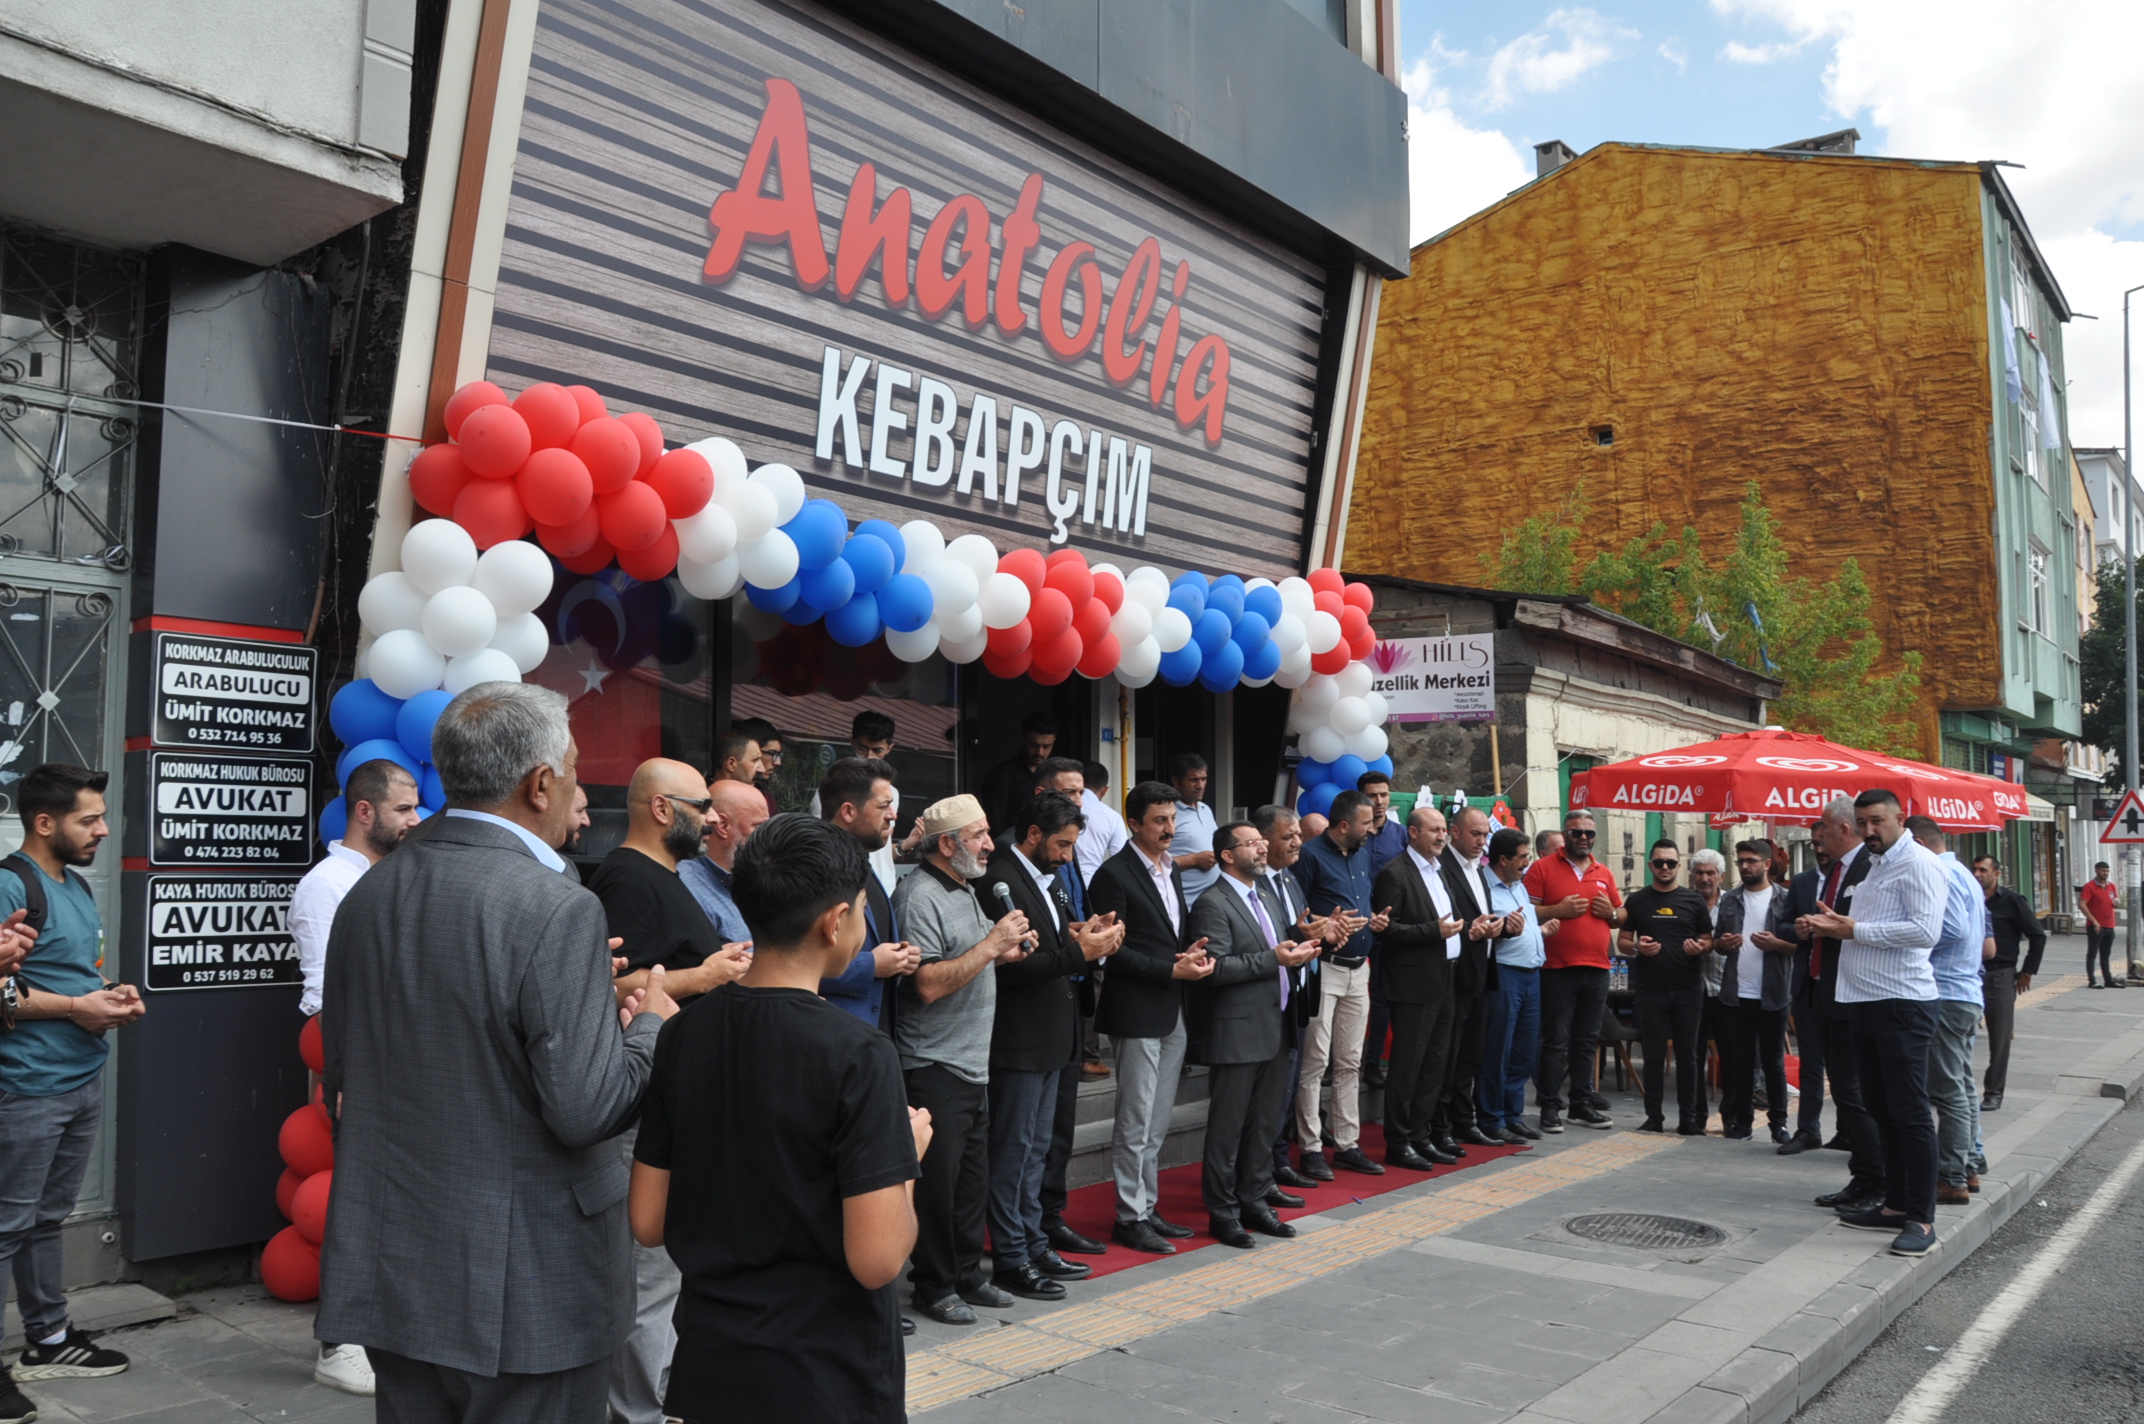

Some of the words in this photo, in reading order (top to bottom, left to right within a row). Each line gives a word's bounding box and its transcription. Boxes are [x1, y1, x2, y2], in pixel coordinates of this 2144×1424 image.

[701, 77, 1231, 450] Anatolia
[815, 344, 1152, 545] KEBAPÇIM
[165, 642, 223, 663] KORKMAZ
[223, 649, 310, 671] ARABULUCULUK
[174, 671, 300, 698] ARABULUCU
[1424, 670, 1490, 690] Merkezi
[165, 699, 213, 722] ÜMİT
[216, 706, 306, 729] KORKMAZ
[188, 728, 197, 739] 0
[199, 728, 222, 741] 532
[223, 730, 247, 743] 714
[249, 732, 265, 744] 95
[266, 733, 282, 744] 36
[160, 762, 219, 779] KORKMAZ
[220, 765, 260, 781] HUKUK
[261, 764, 305, 783] BÜROSU
[174, 786, 293, 812] AVUKAT
[161, 818, 209, 840] ÜMİT
[212, 823, 303, 841] KORKMAZ
[184, 845, 193, 857] 0
[195, 846, 219, 858] 474
[221, 847, 243, 858] 223
[245, 847, 261, 858] 82
[263, 847, 280, 858] 04
[155, 883, 192, 899] KAYA
[195, 883, 247, 899] HUKUK
[249, 880, 298, 899] BÜROS
[152, 940, 224, 966] EMİR
[232, 942, 301, 963] KAYA
[183, 971, 191, 983] 0
[194, 971, 216, 982] 537
[218, 970, 240, 981] 519
[242, 969, 257, 980] 29
[259, 968, 274, 979] 62
